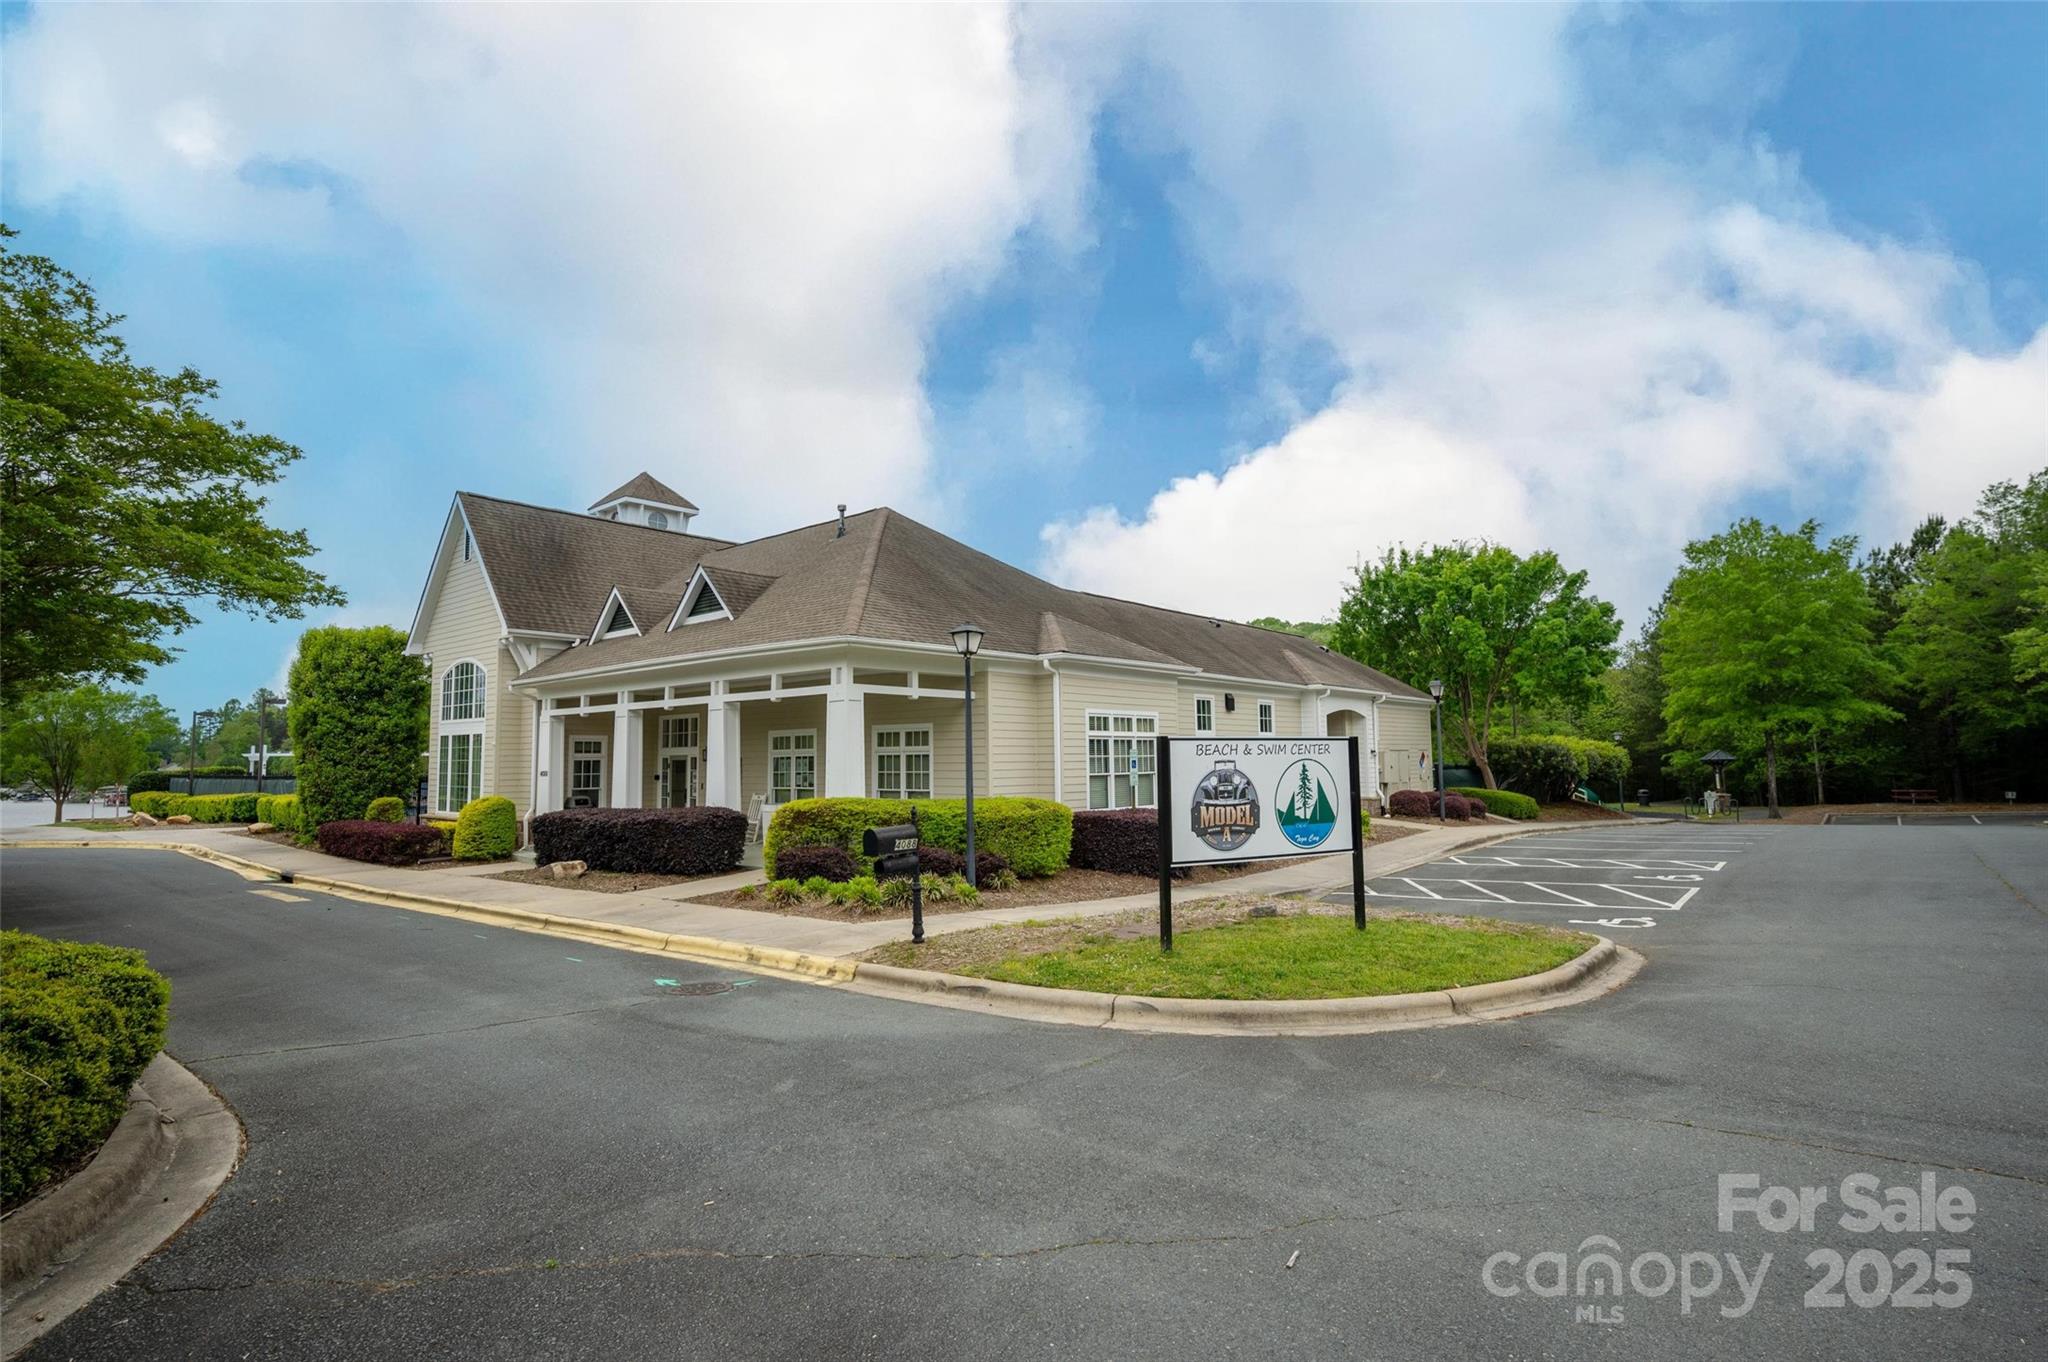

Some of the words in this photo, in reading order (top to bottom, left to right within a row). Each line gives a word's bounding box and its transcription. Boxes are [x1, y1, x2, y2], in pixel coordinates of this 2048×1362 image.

[1195, 743, 1239, 756] BEACH
[1243, 743, 1252, 755] &
[1257, 743, 1287, 755] SWIM
[1290, 743, 1331, 755] CENTER
[1199, 804, 1254, 828] MODEL
[1222, 826, 1232, 842] A
